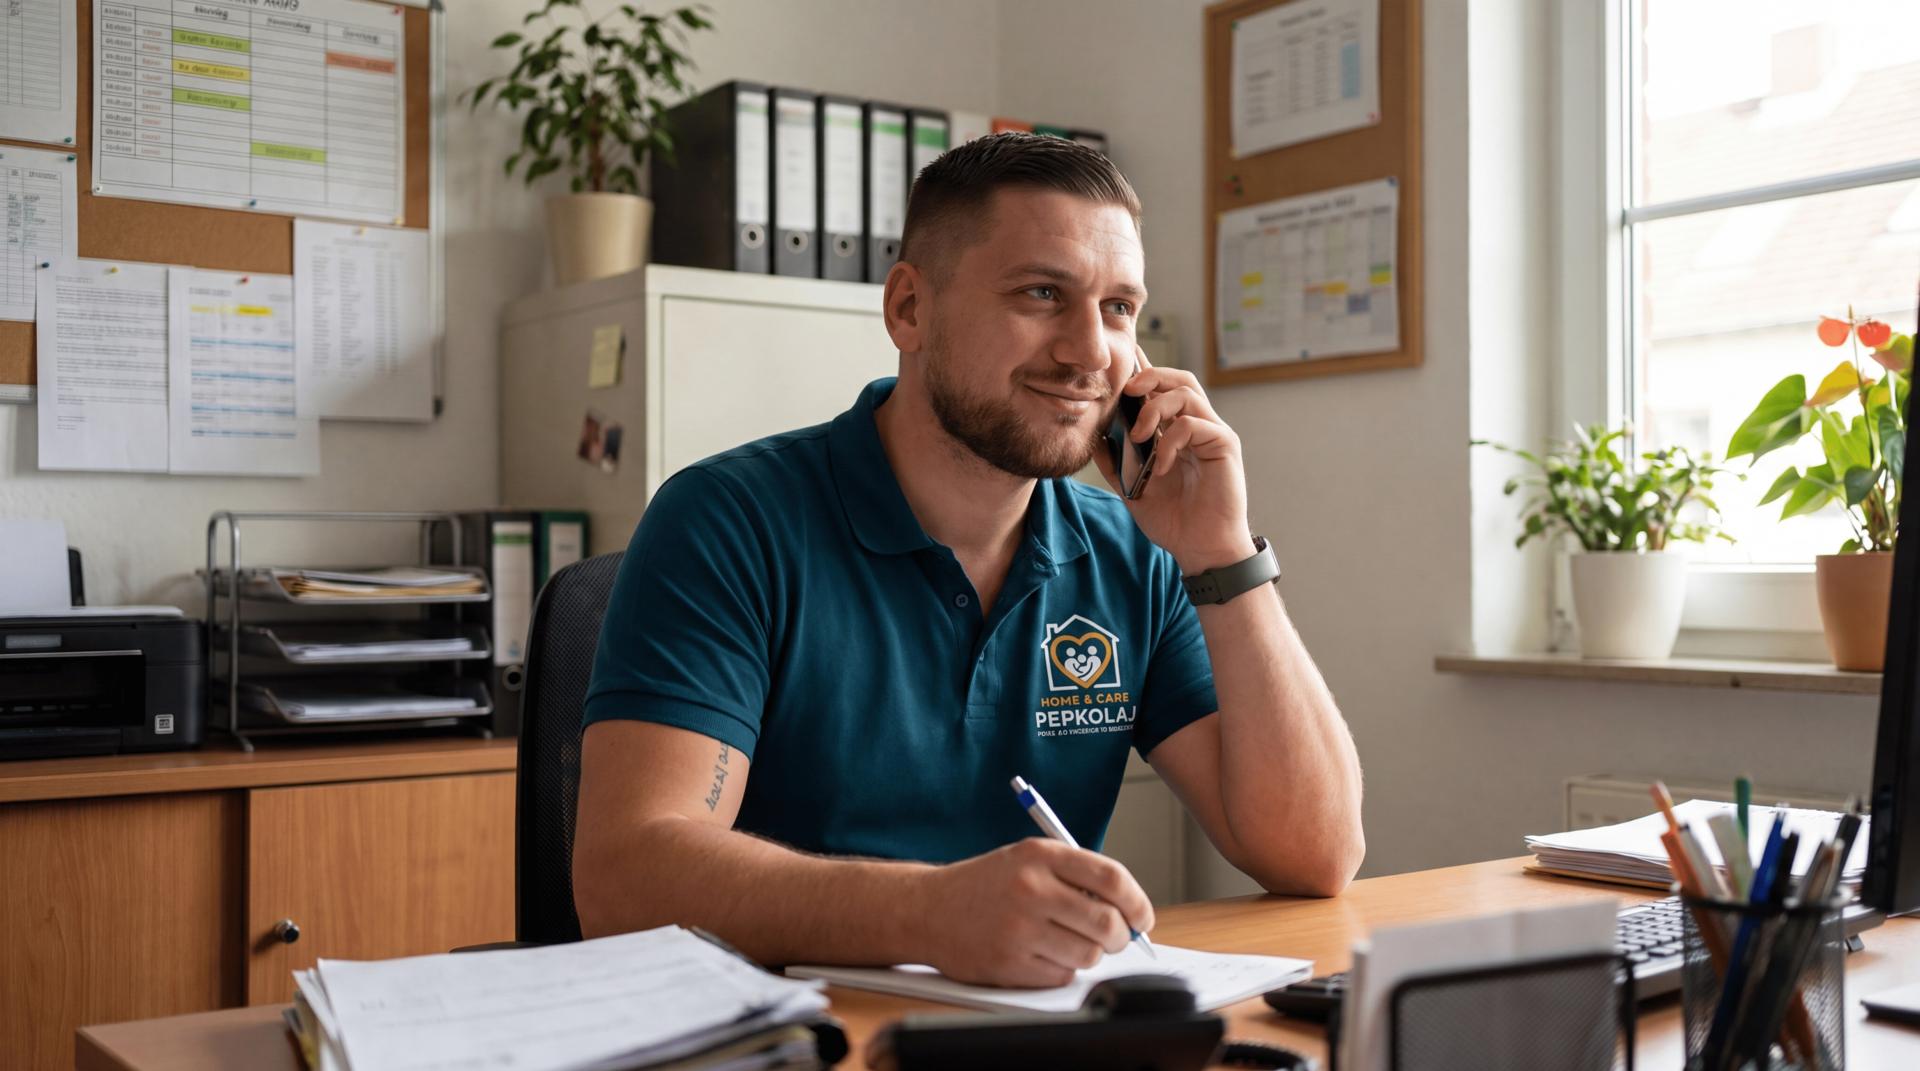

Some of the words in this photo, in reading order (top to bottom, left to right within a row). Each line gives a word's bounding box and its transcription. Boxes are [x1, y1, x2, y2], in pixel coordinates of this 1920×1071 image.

[1041, 695, 1080, 707] HOME
[1084, 694, 1092, 704] &
[1096, 692, 1129, 704] CARE
[1035, 705, 1137, 728] PEPKOLAJ
